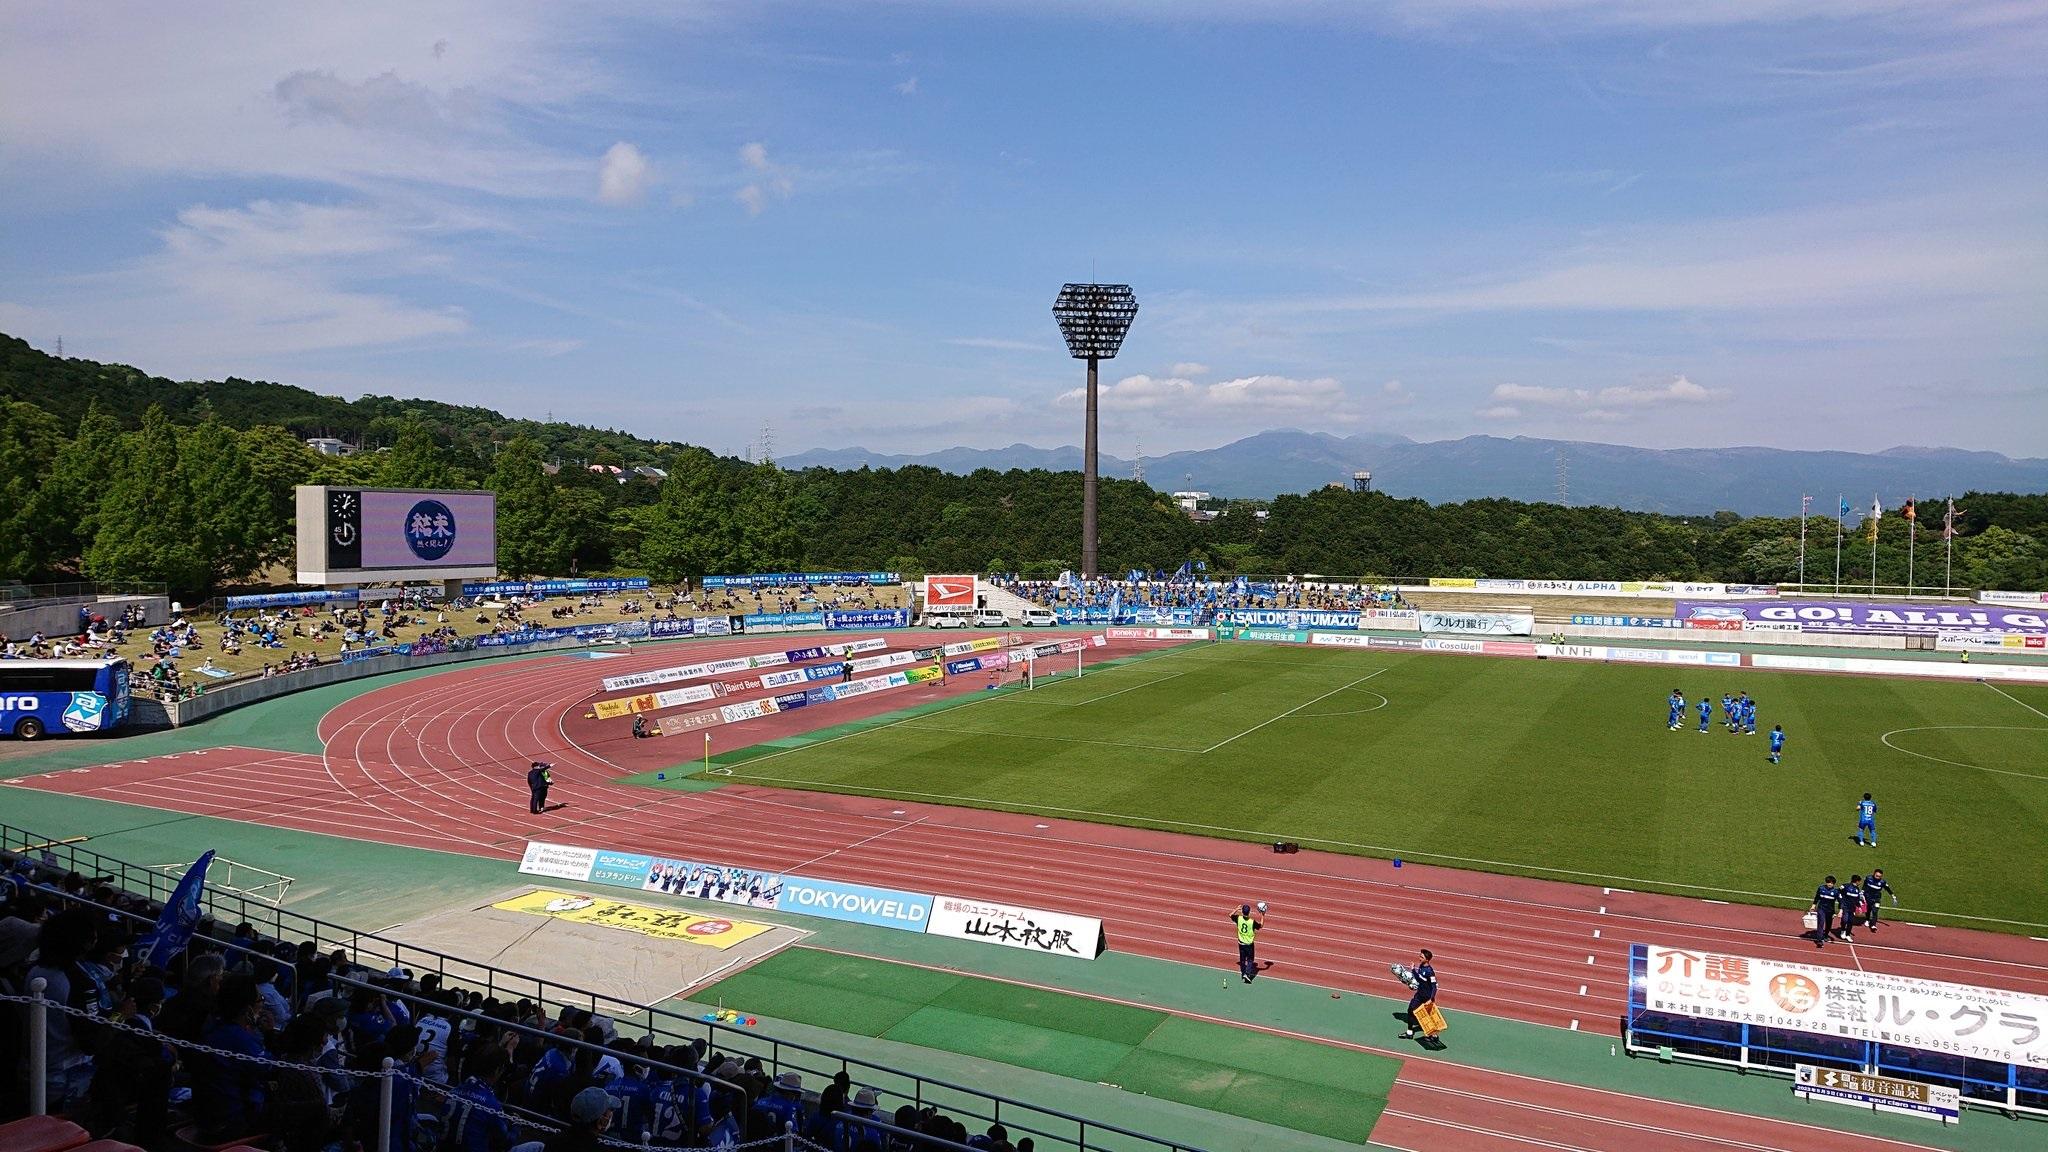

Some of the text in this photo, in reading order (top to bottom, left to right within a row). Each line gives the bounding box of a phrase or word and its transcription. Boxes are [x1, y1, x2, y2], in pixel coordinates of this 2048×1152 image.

[1577, 583, 1616, 591] ALPHA
[1302, 612, 1358, 627] NUMAZU
[1434, 616, 1489, 631] スルガ銀行
[1759, 607, 1854, 621] GO!
[1866, 609, 1991, 626] ALL!
[2002, 613, 2048, 628] G
[726, 680, 761, 692] Baird Beer
[0, 696, 39, 711] ro
[1864, 806, 1873, 815] 18
[786, 886, 925, 922] TOKYOWELD
[943, 900, 1026, 923] 職場のユニフォーム
[1240, 922, 1249, 934] 8
[1655, 950, 1751, 986] 介護
[1657, 980, 1751, 1005] のことなら
[1825, 984, 1868, 1004] 株式
[1826, 1002, 1868, 1023] 会社
[1893, 1033, 2011, 1061] 055-955-7776
[1861, 1077, 1921, 1100] 観音温泉
[1930, 1089, 1959, 1100] スペシャル
[1935, 1096, 1953, 1104] マッチ
